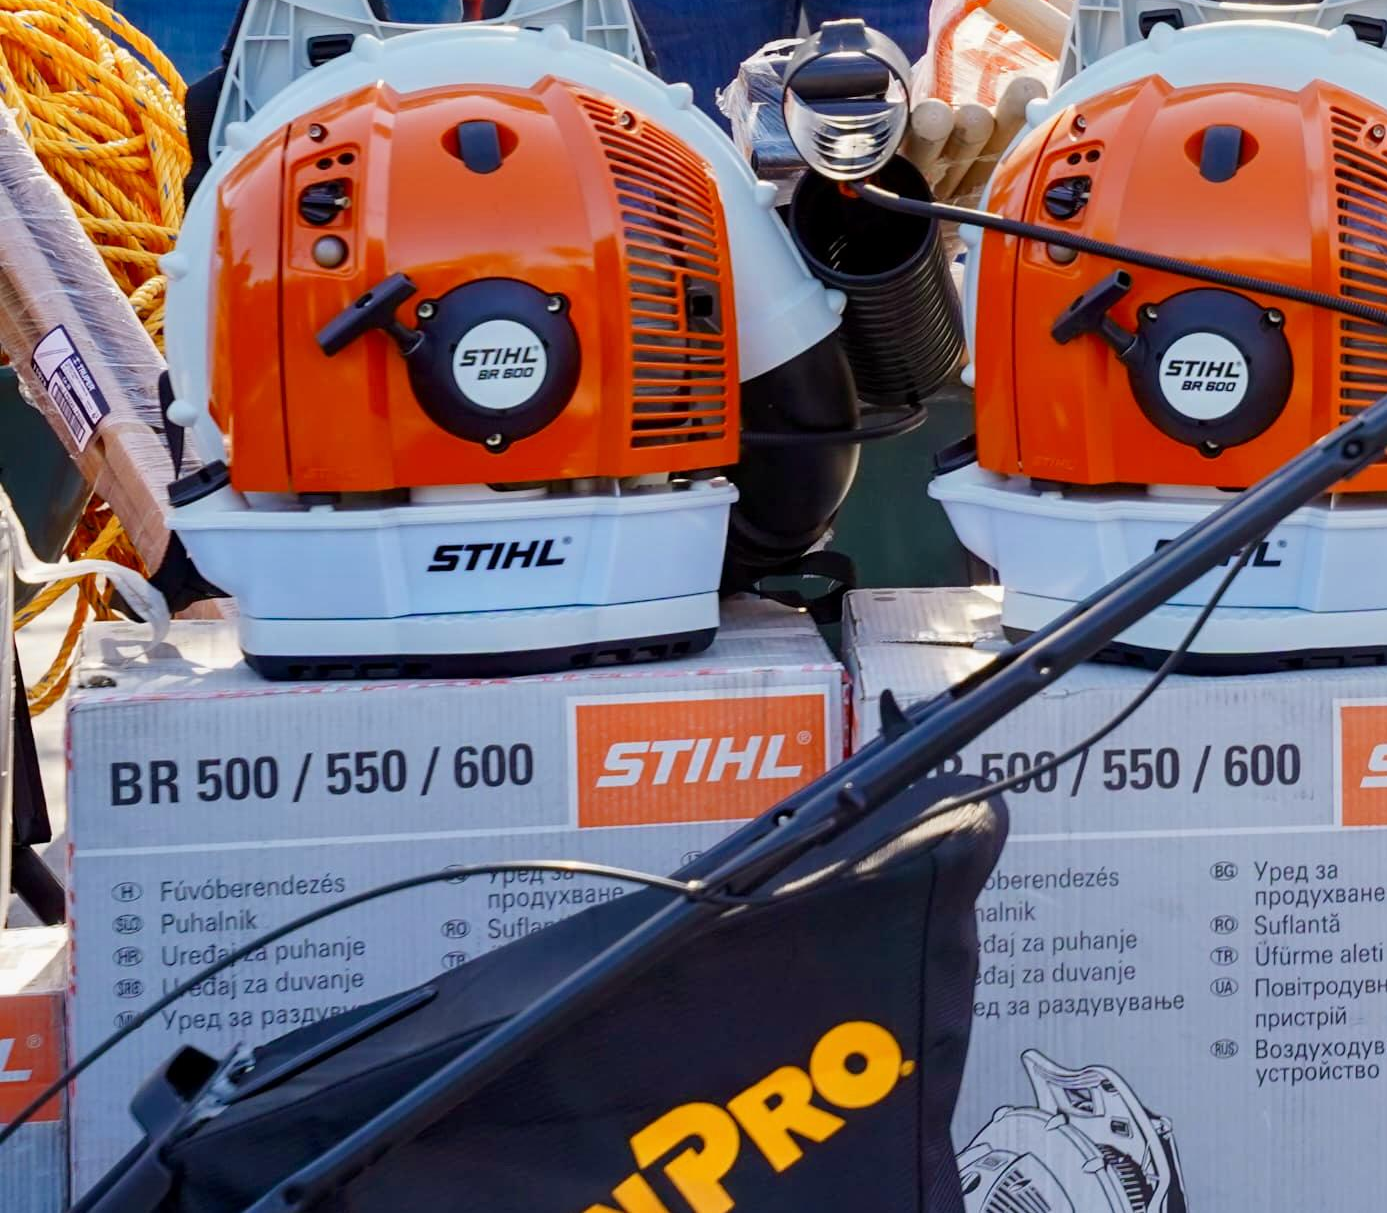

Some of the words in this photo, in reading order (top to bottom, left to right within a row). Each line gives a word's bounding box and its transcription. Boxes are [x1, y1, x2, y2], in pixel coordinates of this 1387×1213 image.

[459, 346, 538, 366] STIHL
[1164, 360, 1240, 378] STIHL
[477, 369, 500, 380] BR
[501, 367, 534, 378] 600
[1181, 380, 1203, 391] BR
[1205, 381, 1237, 392] 600
[426, 539, 567, 572] STIHL
[110, 759, 179, 806] BR
[196, 755, 279, 802] 500
[293, 753, 312, 802] /
[326, 749, 407, 795] 550
[419, 746, 441, 796] /
[453, 742, 534, 788] 600
[595, 734, 803, 788] STIHL
[1103, 747, 1180, 792] 550
[1192, 745, 1212, 793] /
[1224, 743, 1301, 787] 600
[1214, 865, 1236, 878] BG
[1254, 861, 1309, 886] Уред
[1315, 863, 1338, 880] за
[119, 886, 134, 899] H
[160, 872, 346, 903] Fúvóberendezés
[1254, 885, 1386, 910] продухване
[160, 909, 258, 935] Puhalnik
[445, 921, 467, 936] RO
[1214, 918, 1235, 931] RO
[1254, 913, 1341, 936] Suflantă
[275, 936, 366, 964] puhanje
[1021, 938, 1045, 953] za
[1052, 929, 1138, 955] puhanje
[1215, 950, 1234, 963] TR
[1255, 940, 1334, 967] Üfürme
[1340, 941, 1384, 963] aleti
[243, 977, 268, 994] za
[274, 968, 365, 997] duvanje
[1021, 968, 1045, 984] za
[1052, 960, 1136, 985] duvanje
[1215, 981, 1234, 994] UA
[1007, 1000, 1030, 1016] за
[1038, 993, 1185, 1019] раздувување
[1255, 1006, 1347, 1032] пристрій
[161, 1008, 220, 1034] Уред
[228, 1009, 253, 1028] за
[1215, 1041, 1235, 1056] RUS
[1255, 1061, 1380, 1087] устройство
